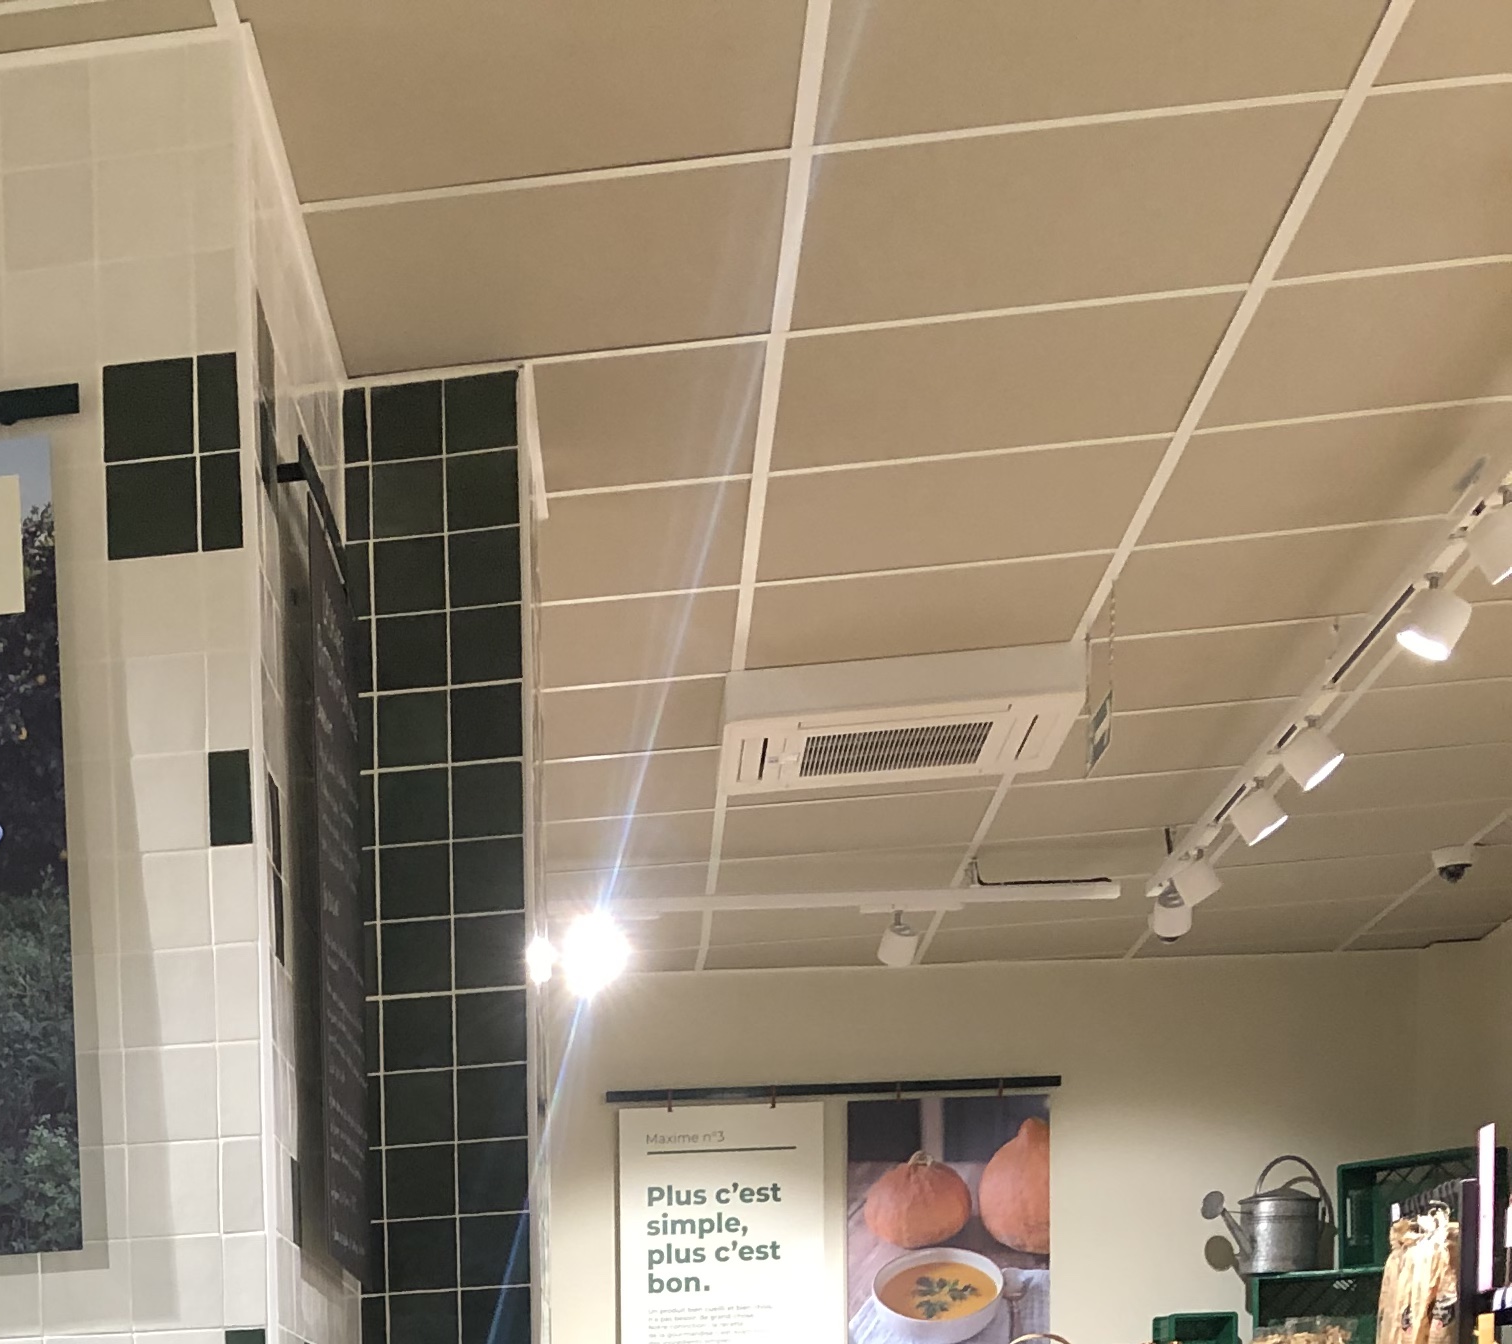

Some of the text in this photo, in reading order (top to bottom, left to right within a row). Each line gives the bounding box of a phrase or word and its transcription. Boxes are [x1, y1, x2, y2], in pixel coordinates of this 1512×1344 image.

[646, 1133, 700, 1145] Maxime
[647, 1182, 782, 1207] Plus c'est
[647, 1212, 748, 1239] simple,
[647, 1240, 781, 1270] plus c'est
[648, 1273, 710, 1294] bon.
